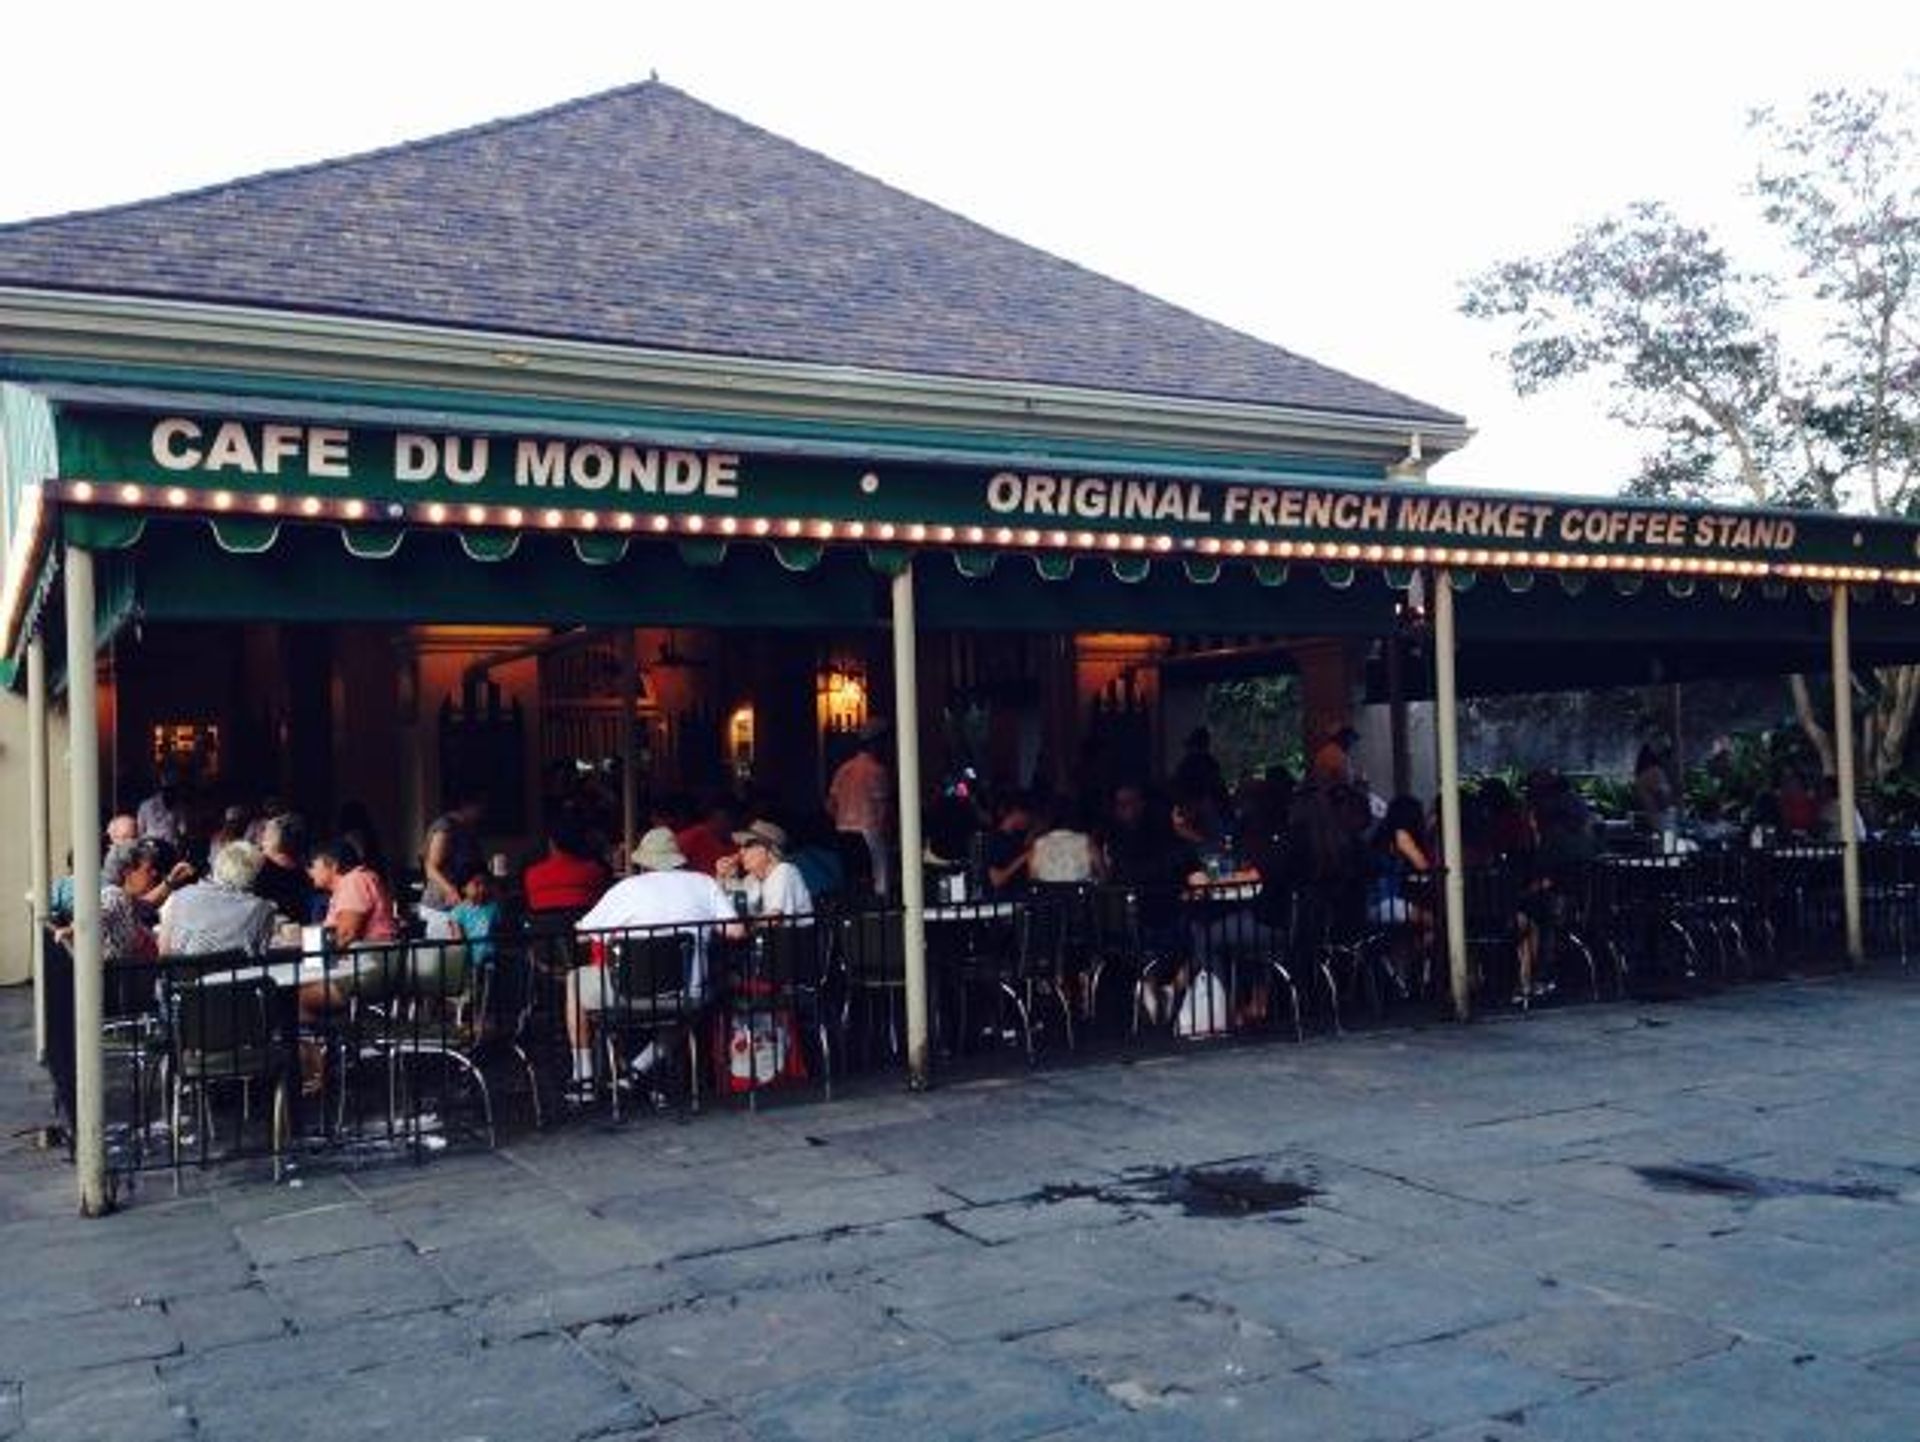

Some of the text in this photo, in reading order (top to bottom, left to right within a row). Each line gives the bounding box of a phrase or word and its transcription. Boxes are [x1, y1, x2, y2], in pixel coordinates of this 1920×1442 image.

[151, 418, 740, 498] CAFE DU MONDE
[987, 474, 1796, 551] ORIGINAL FRENCH MARKET COFFEE STAND
